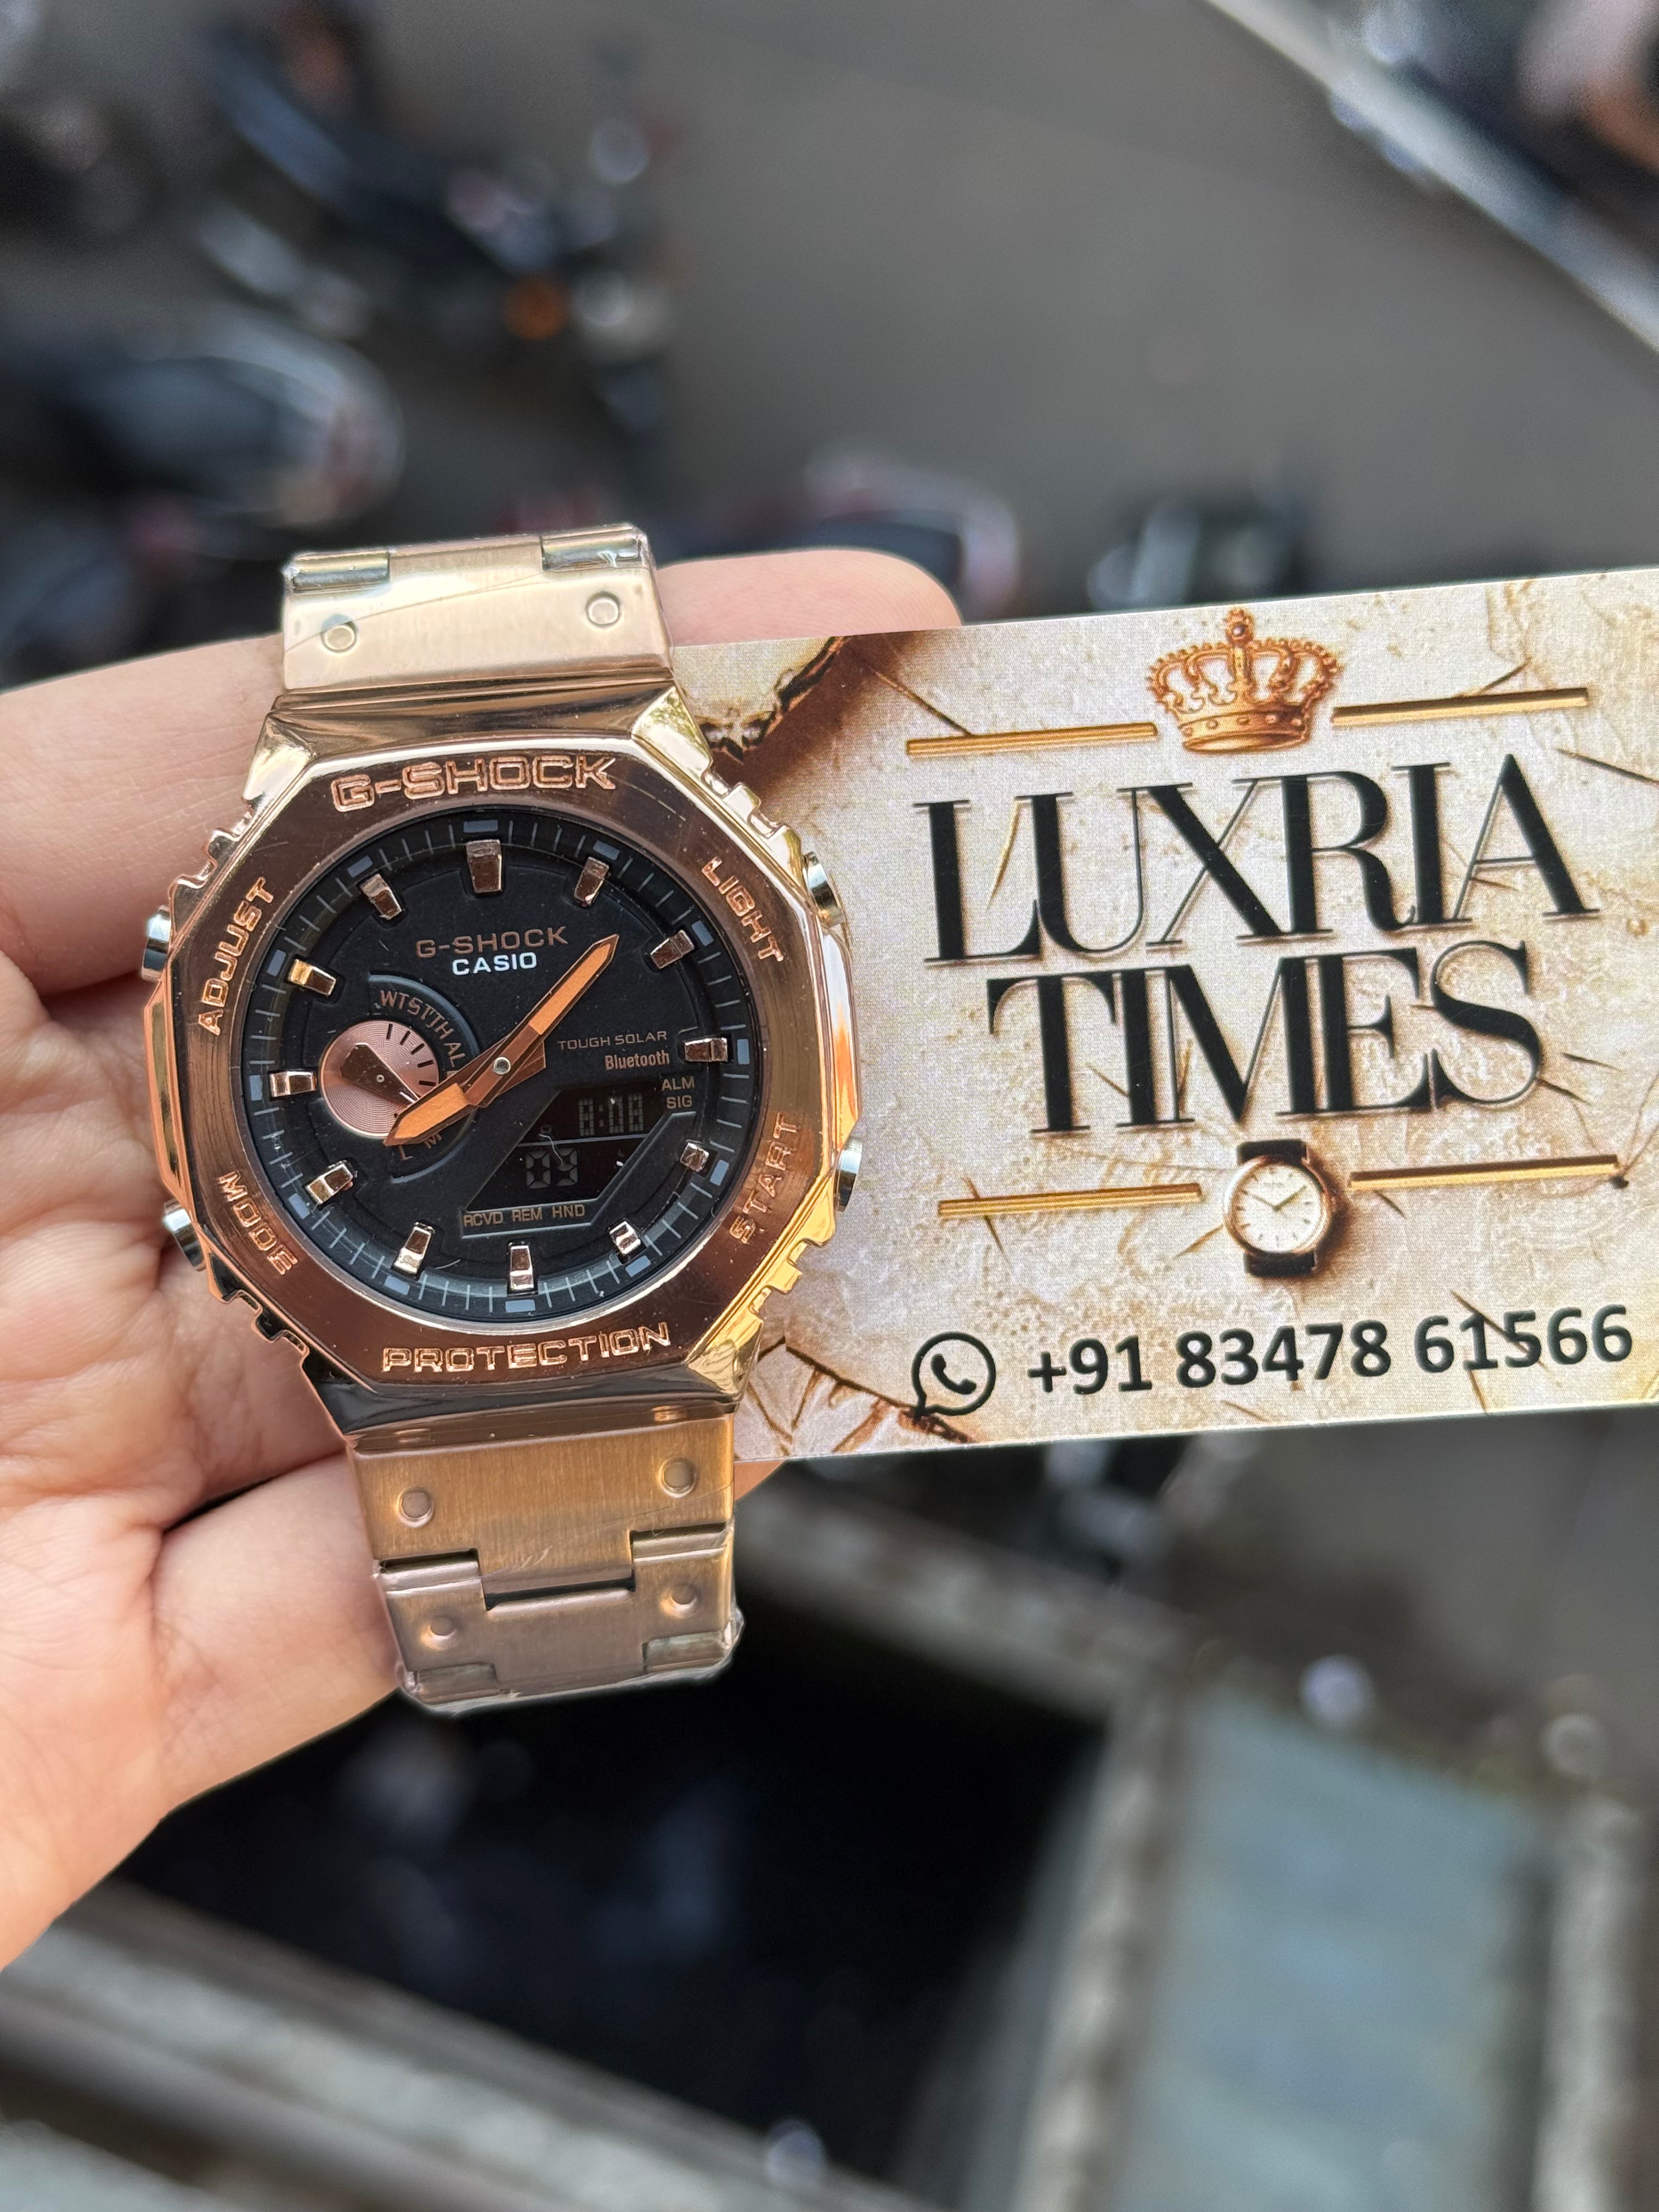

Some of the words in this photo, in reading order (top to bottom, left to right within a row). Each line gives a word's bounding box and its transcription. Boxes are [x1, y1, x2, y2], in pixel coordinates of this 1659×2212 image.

[331, 755, 616, 812] G-SHOCK
[913, 754, 1601, 962] LUXRIA
[702, 857, 784, 962] LIGHT
[198, 877, 274, 1036] ADJUST
[416, 926, 568, 958] G-SHOCK
[452, 952, 537, 975] CASIO
[557, 1037, 610, 1050] TOUGH
[614, 1031, 667, 1045] SOLAR
[605, 1049, 670, 1070] Bluetooth
[987, 940, 1543, 1134] TIMES
[662, 1076, 695, 1091] ALM
[666, 1095, 693, 1109] SIG
[729, 1112, 800, 1244] START
[218, 1171, 298, 1276] MODE
[463, 1211, 504, 1227] RCVD
[512, 1207, 542, 1222] REM
[552, 1204, 585, 1218] HND
[383, 1322, 670, 1372] PROTECTION
[1028, 1335, 1152, 1396] +91
[1177, 1320, 1391, 1389] 83478
[1415, 1304, 1633, 1373] 61566
